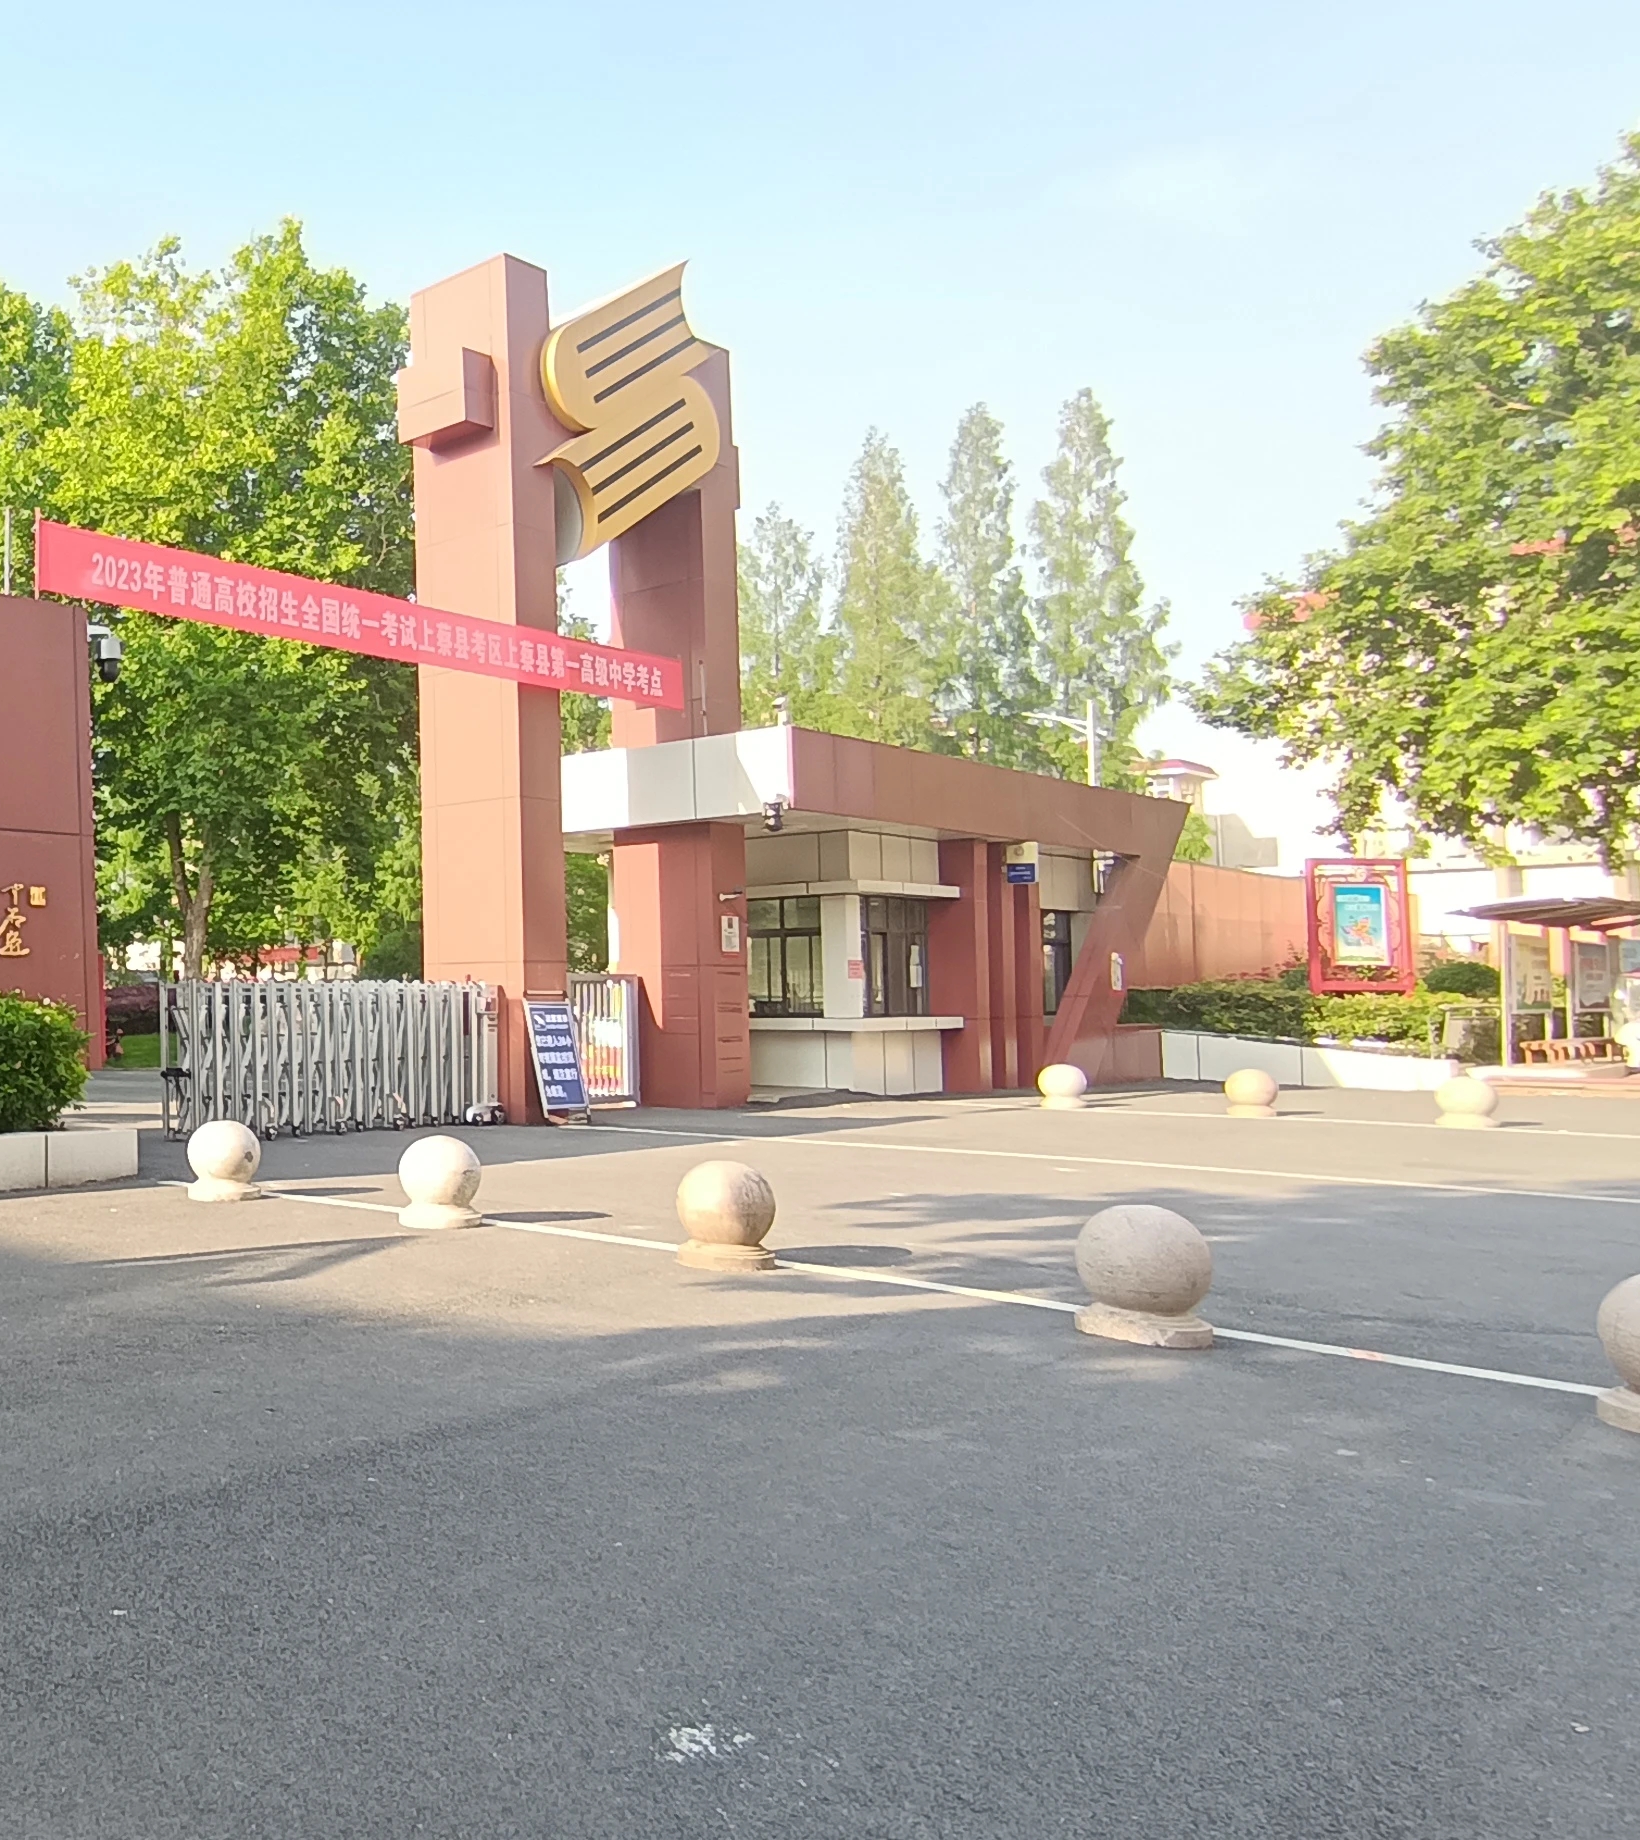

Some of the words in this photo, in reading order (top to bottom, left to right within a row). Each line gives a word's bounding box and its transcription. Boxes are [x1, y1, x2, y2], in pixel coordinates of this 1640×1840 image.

[91, 551, 664, 698] 2023年普通高校招生全国统一考试上蔡县考区上蔡县第一高级中学考点
